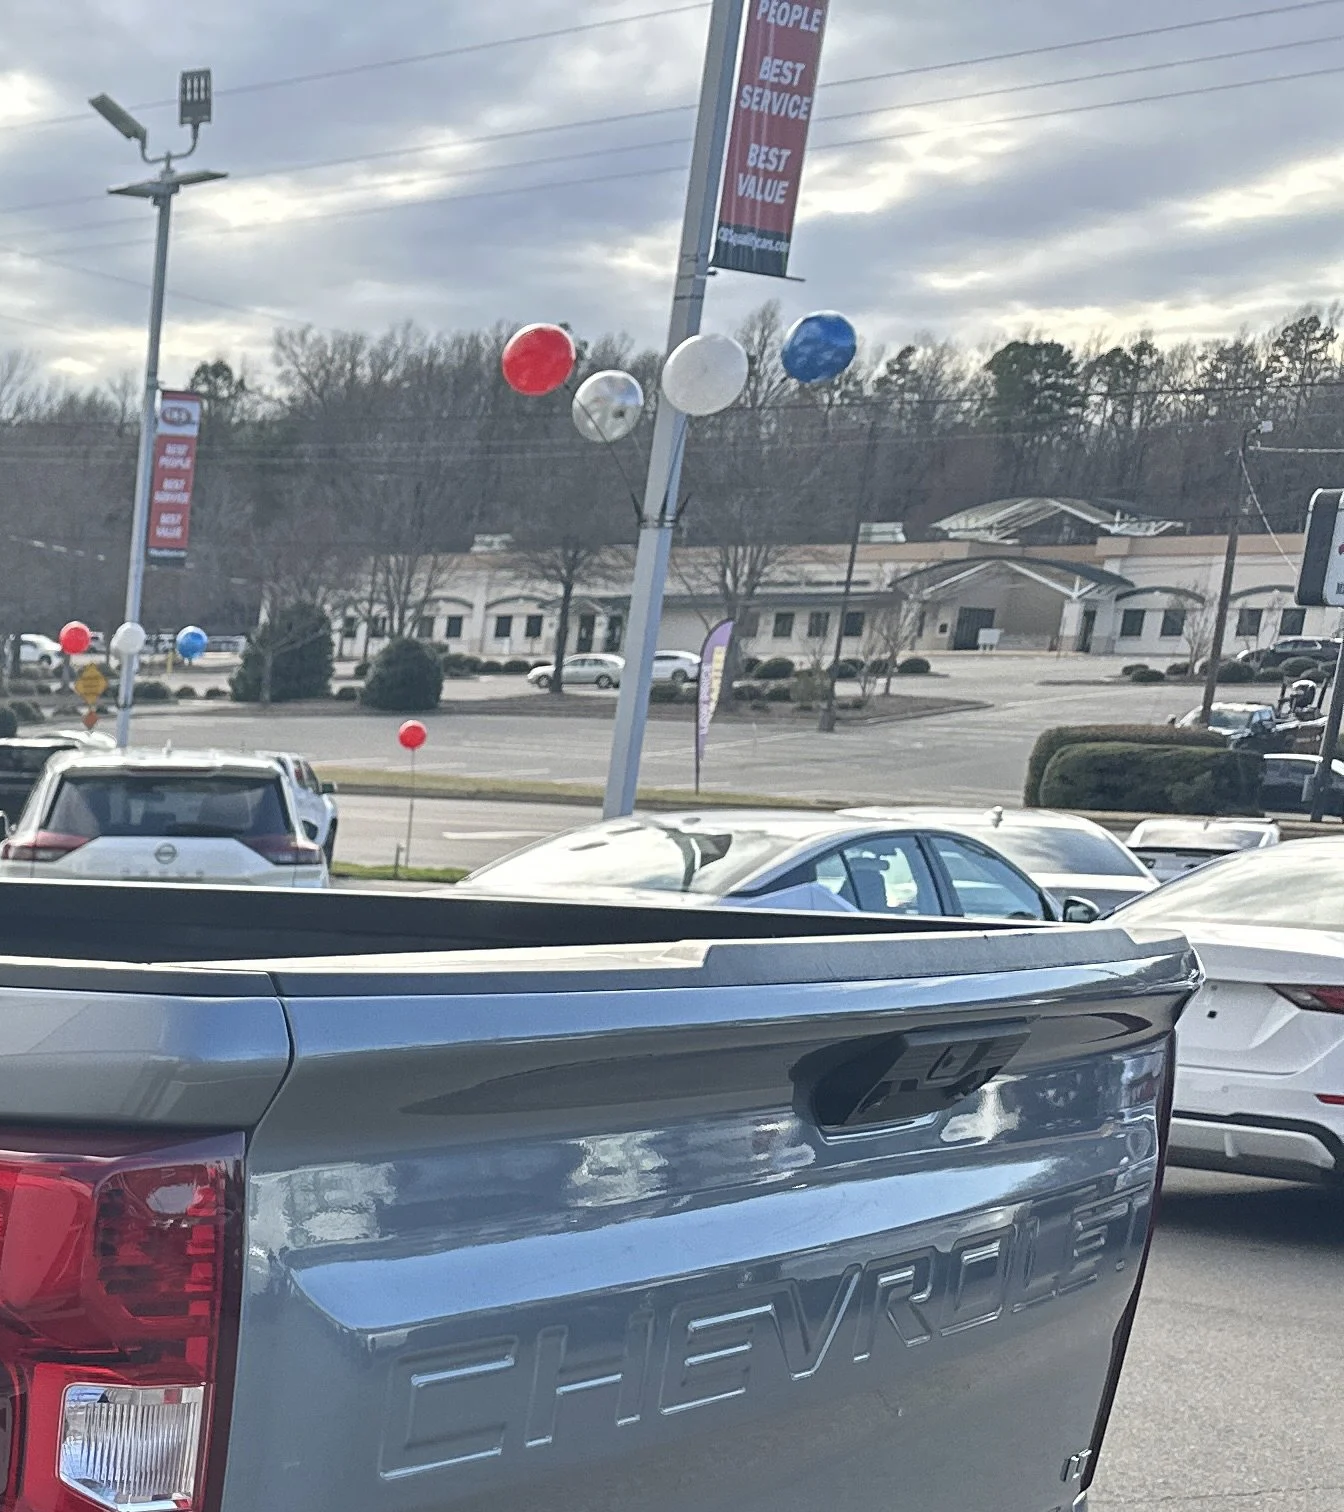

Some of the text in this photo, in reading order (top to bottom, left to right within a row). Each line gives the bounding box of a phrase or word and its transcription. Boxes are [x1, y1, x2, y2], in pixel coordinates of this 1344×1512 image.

[757, 0, 823, 33] PEOPLE
[759, 56, 806, 87] BEST
[740, 84, 812, 120] SERVICE
[747, 142, 791, 172] BEST
[737, 173, 789, 205] VALUE
[376, 1181, 1153, 1481] CHEVROLET
